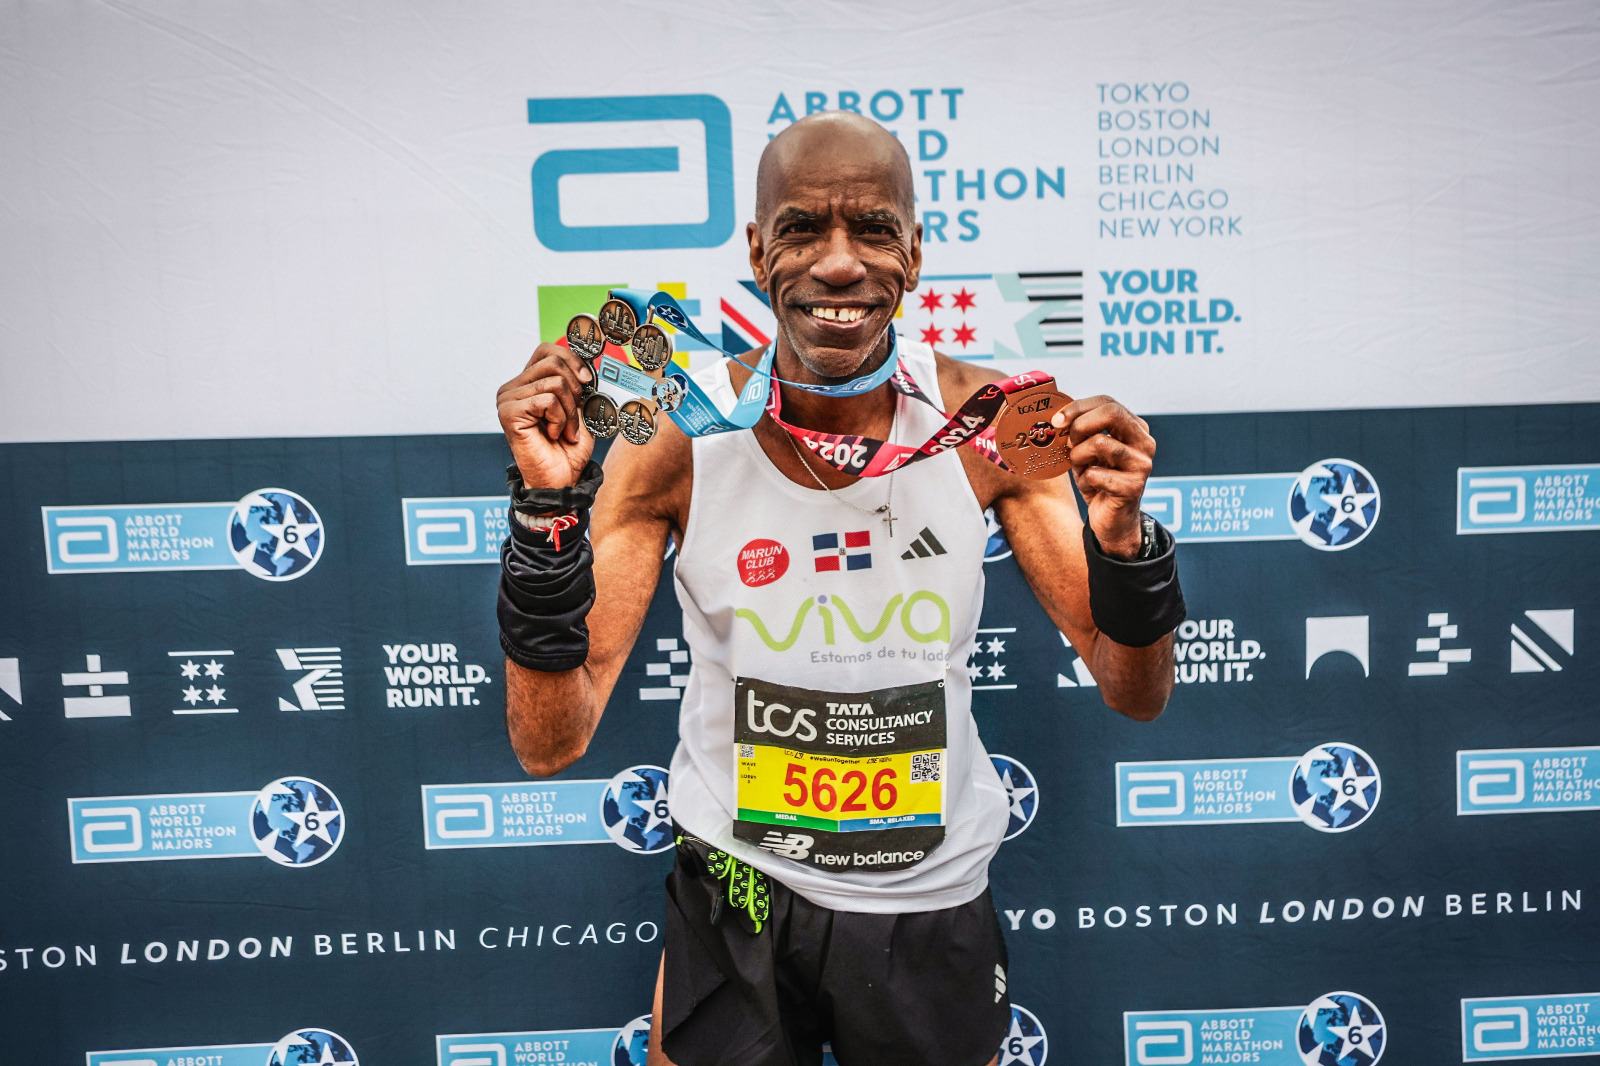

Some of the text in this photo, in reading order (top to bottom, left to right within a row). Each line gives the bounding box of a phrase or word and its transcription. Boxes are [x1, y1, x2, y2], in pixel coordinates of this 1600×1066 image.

[1096, 81, 1190, 104] TOKYO
[1098, 108, 1211, 131] BOSTON
[1099, 135, 1220, 158] LONDON
[1099, 163, 1194, 185] BERLIN
[914, 166, 1065, 202] THON
[1098, 188, 1229, 212] CHICAGO
[1100, 215, 1242, 238] NEW YORK
[1099, 269, 1199, 295] YOUR
[1099, 298, 1242, 326] WORLD.
[1100, 329, 1224, 357] RUN IT.
[930, 415, 985, 453] 2024
[802, 436, 868, 469] 2024
[1534, 475, 1589, 487] ABBOTT
[1191, 485, 1246, 497] ABBOTT
[1534, 486, 1584, 498] WORLD
[1191, 497, 1241, 509] WORLD
[1341, 495, 1356, 513] 6
[1534, 497, 1600, 510] MARATH
[124, 514, 183, 526] ABBOTT
[1191, 508, 1274, 520] MARATHON
[1534, 509, 1592, 522] MAJORS
[125, 526, 179, 538] WORLD
[1191, 520, 1250, 532] MAJORS
[283, 525, 298, 544] 6
[127, 537, 214, 550] MARATHON
[128, 550, 190, 562] MAJORS
[741, 545, 783, 560] MARUN
[746, 556, 775, 570] CLUB
[735, 590, 951, 652] viva
[1174, 619, 1235, 640] OUR
[382, 643, 458, 664] YOUR
[811, 651, 872, 663] Estamos
[877, 646, 896, 659] de
[901, 648, 917, 660] tu
[384, 662, 491, 687] WORLD.
[1224, 662, 1254, 682] IT.
[387, 686, 480, 708] RUN IT.
[747, 690, 818, 742] tcs
[826, 703, 874, 716] TATA
[825, 710, 934, 731] CONSULTANCY
[826, 732, 896, 746] SERVICES
[1532, 757, 1588, 769] ABBOTT
[1193, 769, 1248, 781] ABBOTT
[1533, 768, 1583, 780] WORLD
[783, 763, 898, 813] 5626
[1193, 781, 1243, 792] WORLD
[1342, 777, 1356, 796] 6
[1533, 778, 1600, 791] MARATHO
[501, 791, 557, 803] ABBOTT
[1193, 790, 1276, 803] MARATHON
[1533, 790, 1592, 803] MAJORS
[148, 804, 206, 816] ABBOTT
[501, 803, 553, 814] WORLD
[654, 800, 670, 819] 6
[1194, 802, 1253, 815] MAJORS
[149, 816, 202, 827] WORLD
[305, 812, 319, 831] 6
[503, 813, 587, 825] MARATHON
[887, 815, 915, 824] RELAXED
[151, 826, 236, 839] MARATHON
[503, 825, 563, 837] MAJORS
[151, 838, 212, 851] MAJORS
[814, 850, 924, 866] new balance
[1078, 903, 1237, 929] BOSTON
[1259, 896, 1425, 923] LONDON
[1445, 889, 1581, 916] BERLIN
[121, 936, 293, 964] LONDON
[314, 929, 456, 956] BERLIN
[479, 921, 658, 949] CHICAGO
[1536, 1003, 1590, 1016] ABBOTT
[1201, 1018, 1255, 1030] ABBOTT
[1536, 1014, 1586, 1026] WORLD
[1201, 1030, 1250, 1041] WORLD
[1348, 1026, 1362, 1045] 6
[1537, 1025, 1600, 1037] MARATH
[514, 1040, 570, 1053] ABBOTT
[1008, 1037, 1024, 1056] 6
[1202, 1040, 1283, 1053] MARATHON
[1537, 1036, 1595, 1049] MAJORS
[167, 1055, 223, 1066] ABBOTT
[514, 1052, 565, 1063] WORLD
[1202, 1052, 1260, 1064] MAJORS
